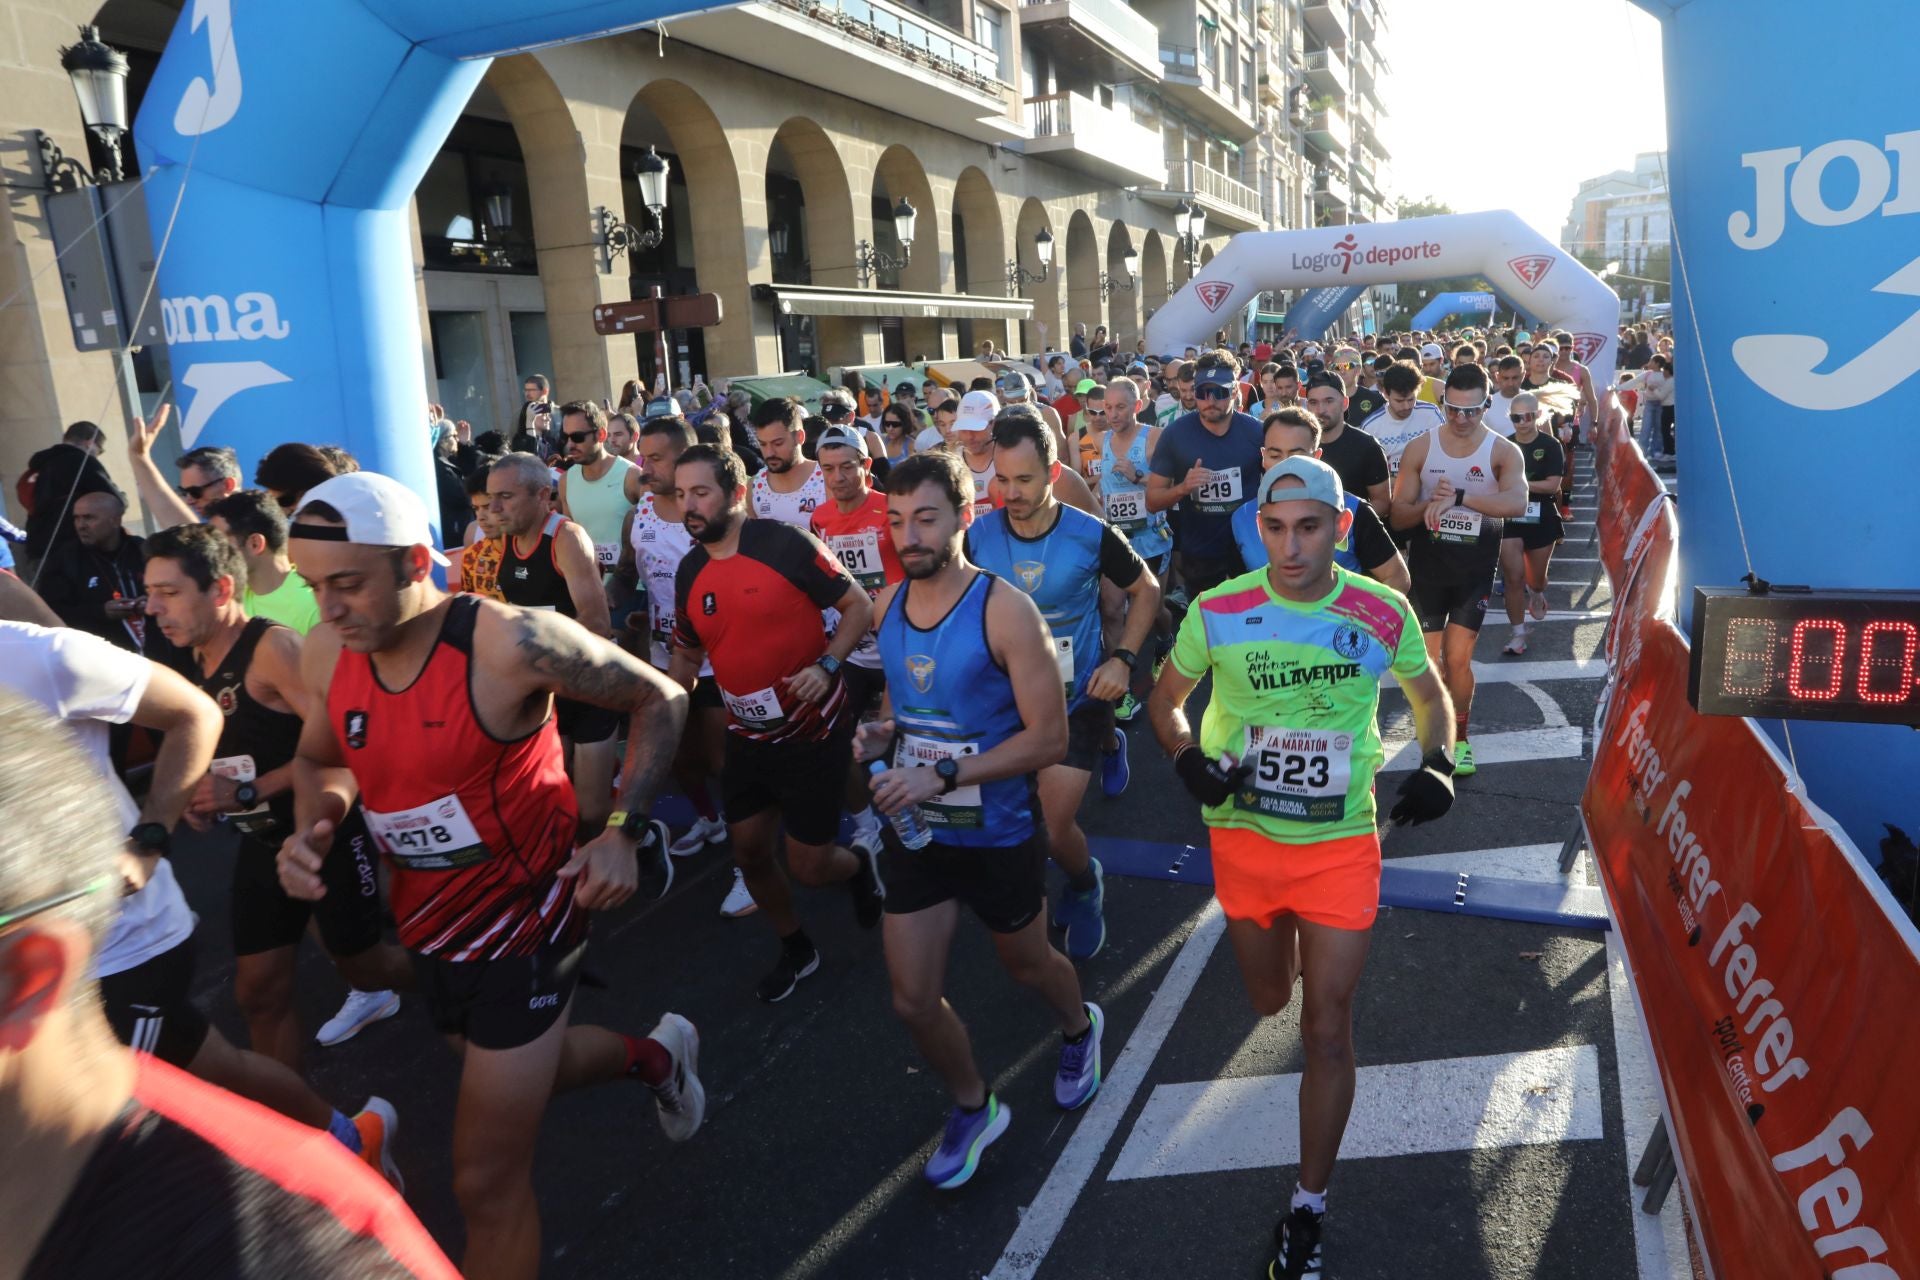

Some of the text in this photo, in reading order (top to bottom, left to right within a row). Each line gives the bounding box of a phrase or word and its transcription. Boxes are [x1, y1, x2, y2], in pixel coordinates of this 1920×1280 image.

[1366, 241, 1441, 266] deporte
[1459, 294, 1495, 304] POWER
[1200, 481, 1232, 499] 219
[798, 497, 816, 514] 20
[1110, 502, 1138, 518] 323
[1440, 518, 1473, 531] 2058
[1245, 649, 1270, 662] Club
[1248, 663, 1361, 690] VILLAVERDE
[1266, 735, 1328, 752] LA MARATÓN
[1258, 749, 1330, 789] 523
[1276, 784, 1308, 794] CARLOS
[1279, 798, 1304, 809] RURAL
[384, 825, 452, 848] 1478
[1712, 1013, 1752, 1105] sport center
